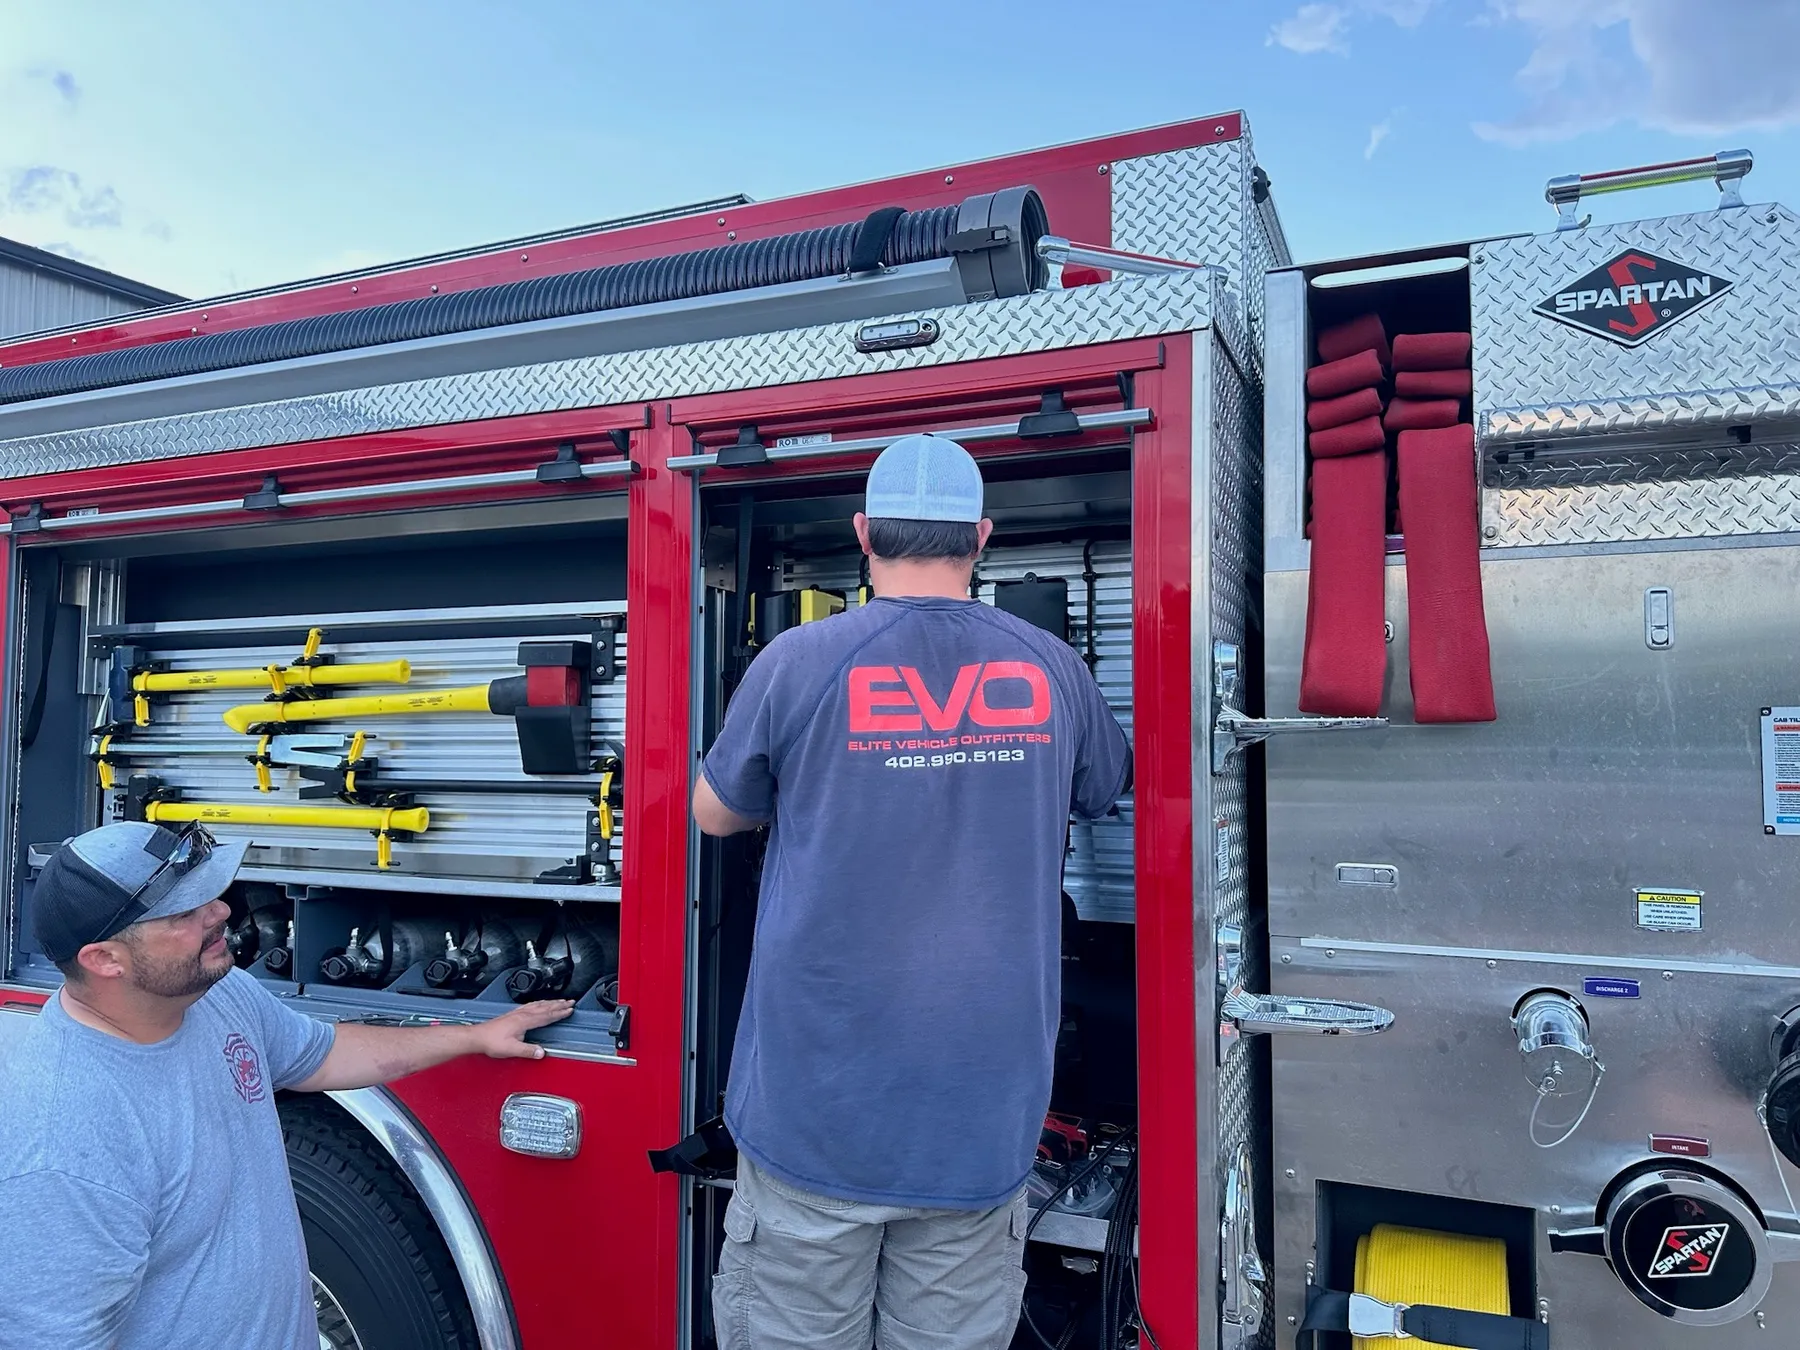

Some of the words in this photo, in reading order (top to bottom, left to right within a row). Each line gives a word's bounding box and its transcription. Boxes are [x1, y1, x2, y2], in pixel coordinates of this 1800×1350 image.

[1555, 275, 1710, 313] SPARTAN
[848, 661, 1052, 732] EVO
[848, 739, 892, 751] ELITE
[895, 736, 958, 750] VEHICLE
[960, 733, 1051, 745] OUTFITTERS
[1655, 1227, 1721, 1275] SPARTAN
